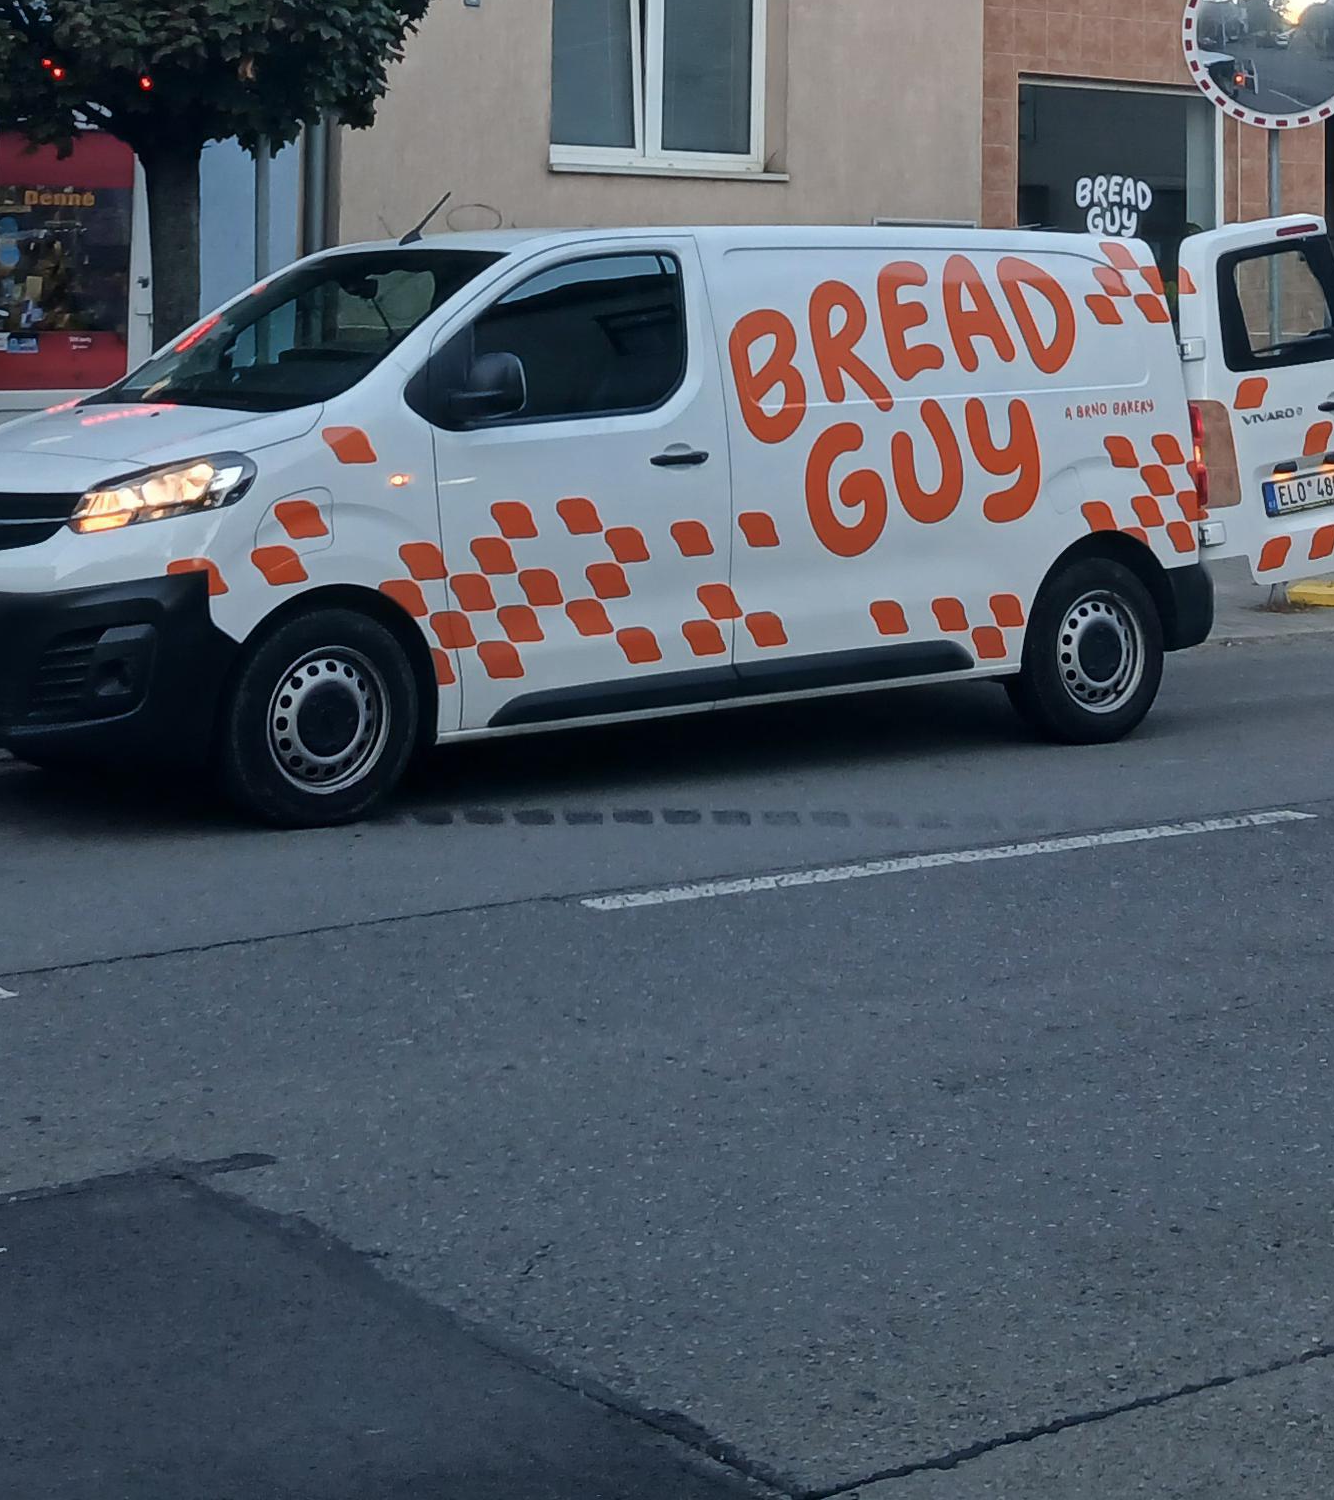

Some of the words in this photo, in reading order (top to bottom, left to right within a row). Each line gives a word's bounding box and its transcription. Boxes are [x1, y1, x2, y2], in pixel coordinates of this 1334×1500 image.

[1075, 175, 1152, 211] BREAD
[1087, 205, 1137, 237] GUY
[728, 253, 1076, 444] BREAD
[1065, 406, 1073, 421] A
[1076, 402, 1108, 419] BRNO
[1113, 398, 1155, 417] BAKERY
[1241, 407, 1296, 426] VIVARO
[805, 397, 1041, 558] GUY
